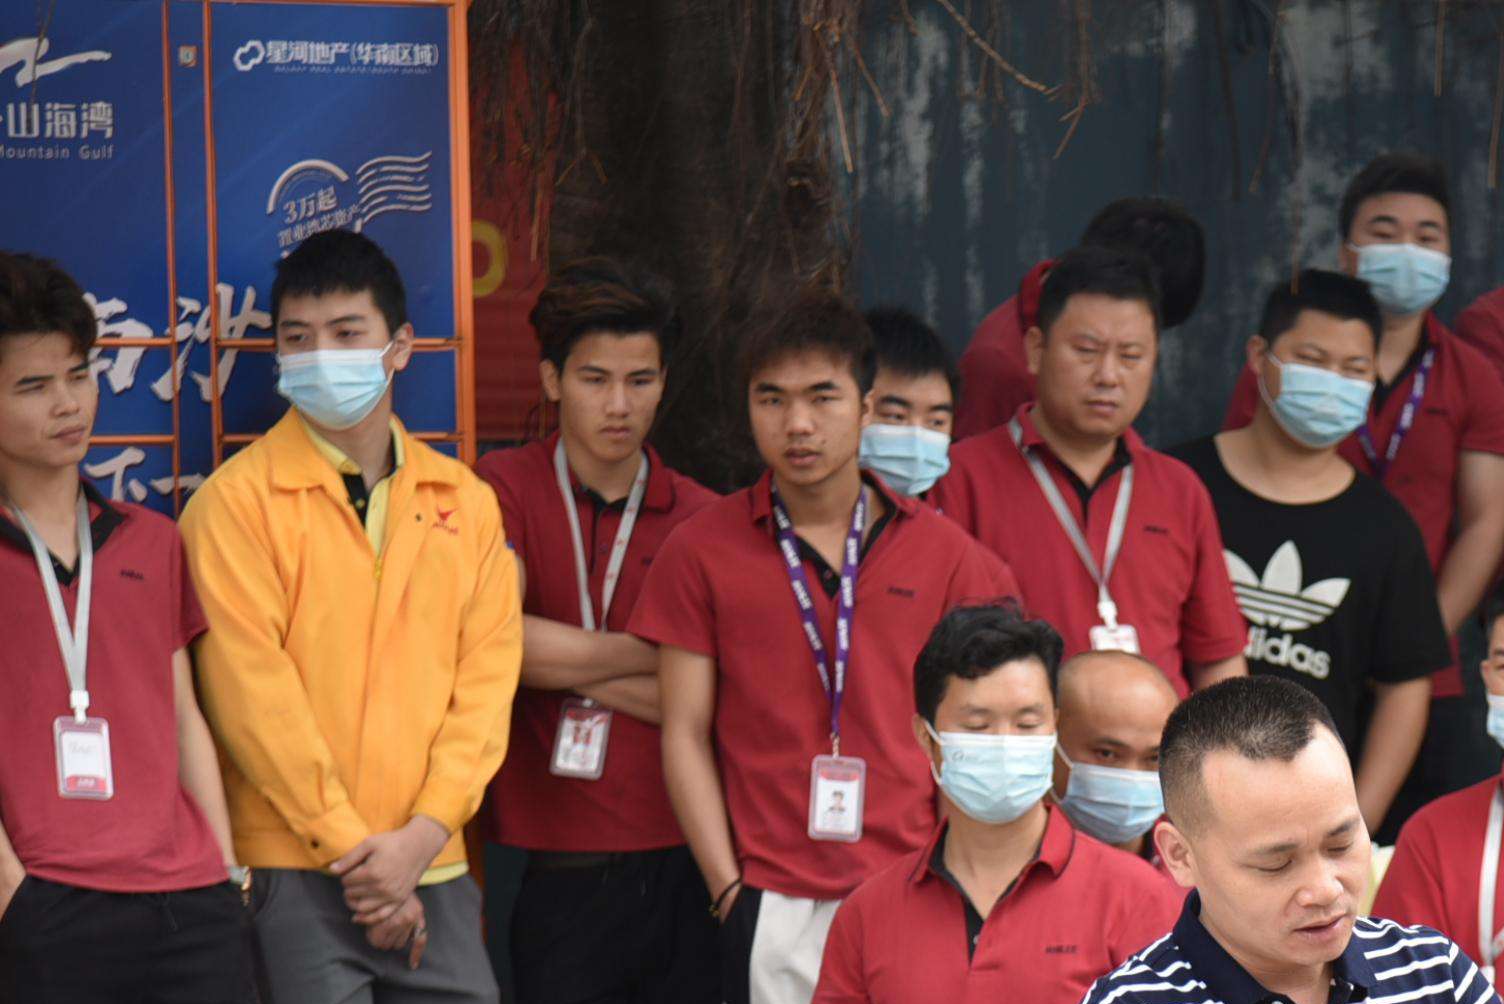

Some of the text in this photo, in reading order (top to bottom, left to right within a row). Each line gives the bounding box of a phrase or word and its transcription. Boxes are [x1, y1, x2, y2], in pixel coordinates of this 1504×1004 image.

[79, 144, 114, 159] Gulf
[283, 185, 338, 224] 3万起
[1244, 626, 1331, 679] idas
